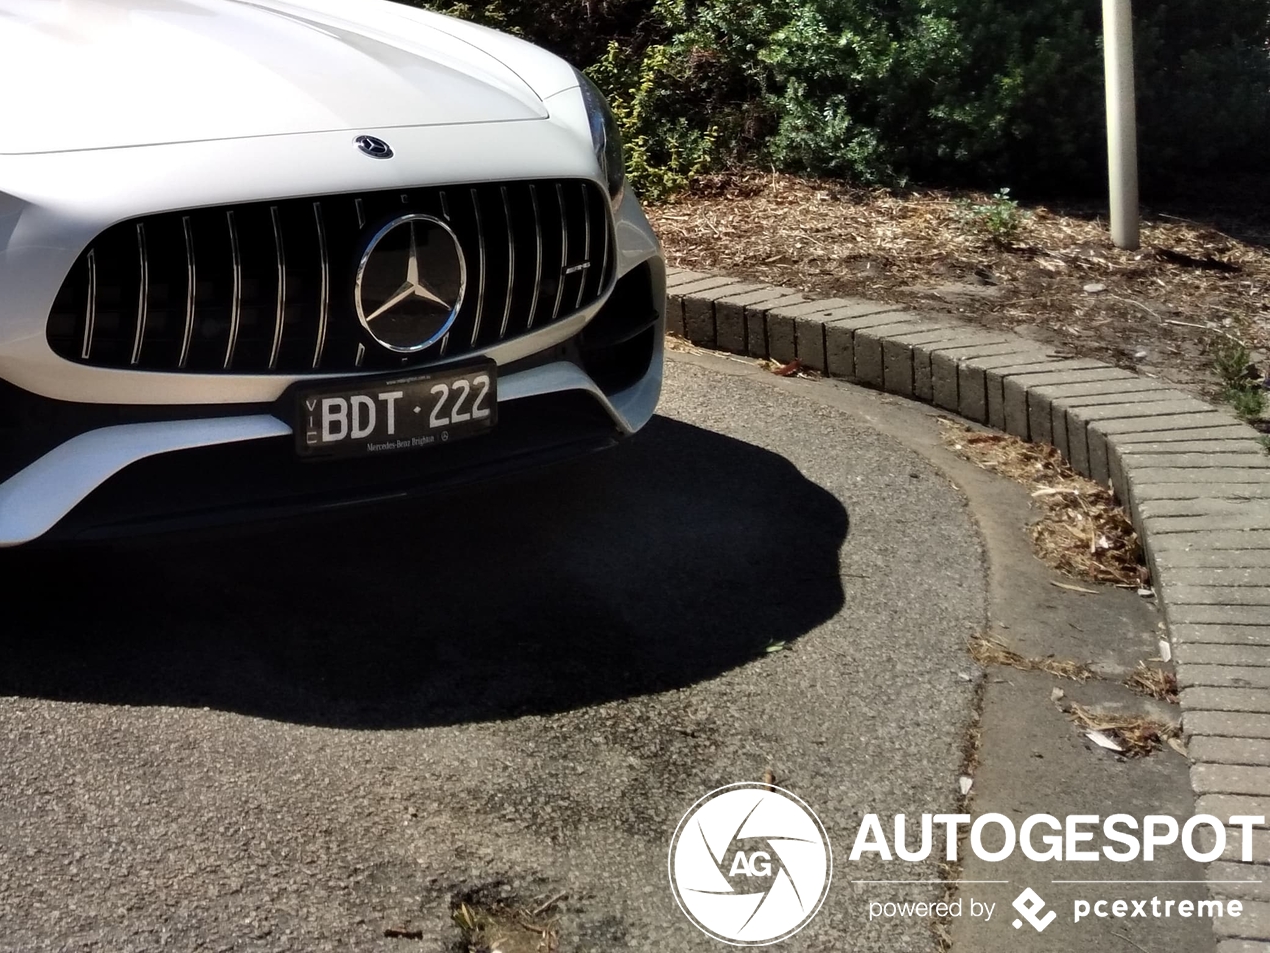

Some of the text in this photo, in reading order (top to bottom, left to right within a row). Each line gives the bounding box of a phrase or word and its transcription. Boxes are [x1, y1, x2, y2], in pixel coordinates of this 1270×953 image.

[306, 399, 317, 444] VIC
[322, 375, 491, 442] BDT 222
[367, 435, 435, 452] Mercedes-Benz Brighton
